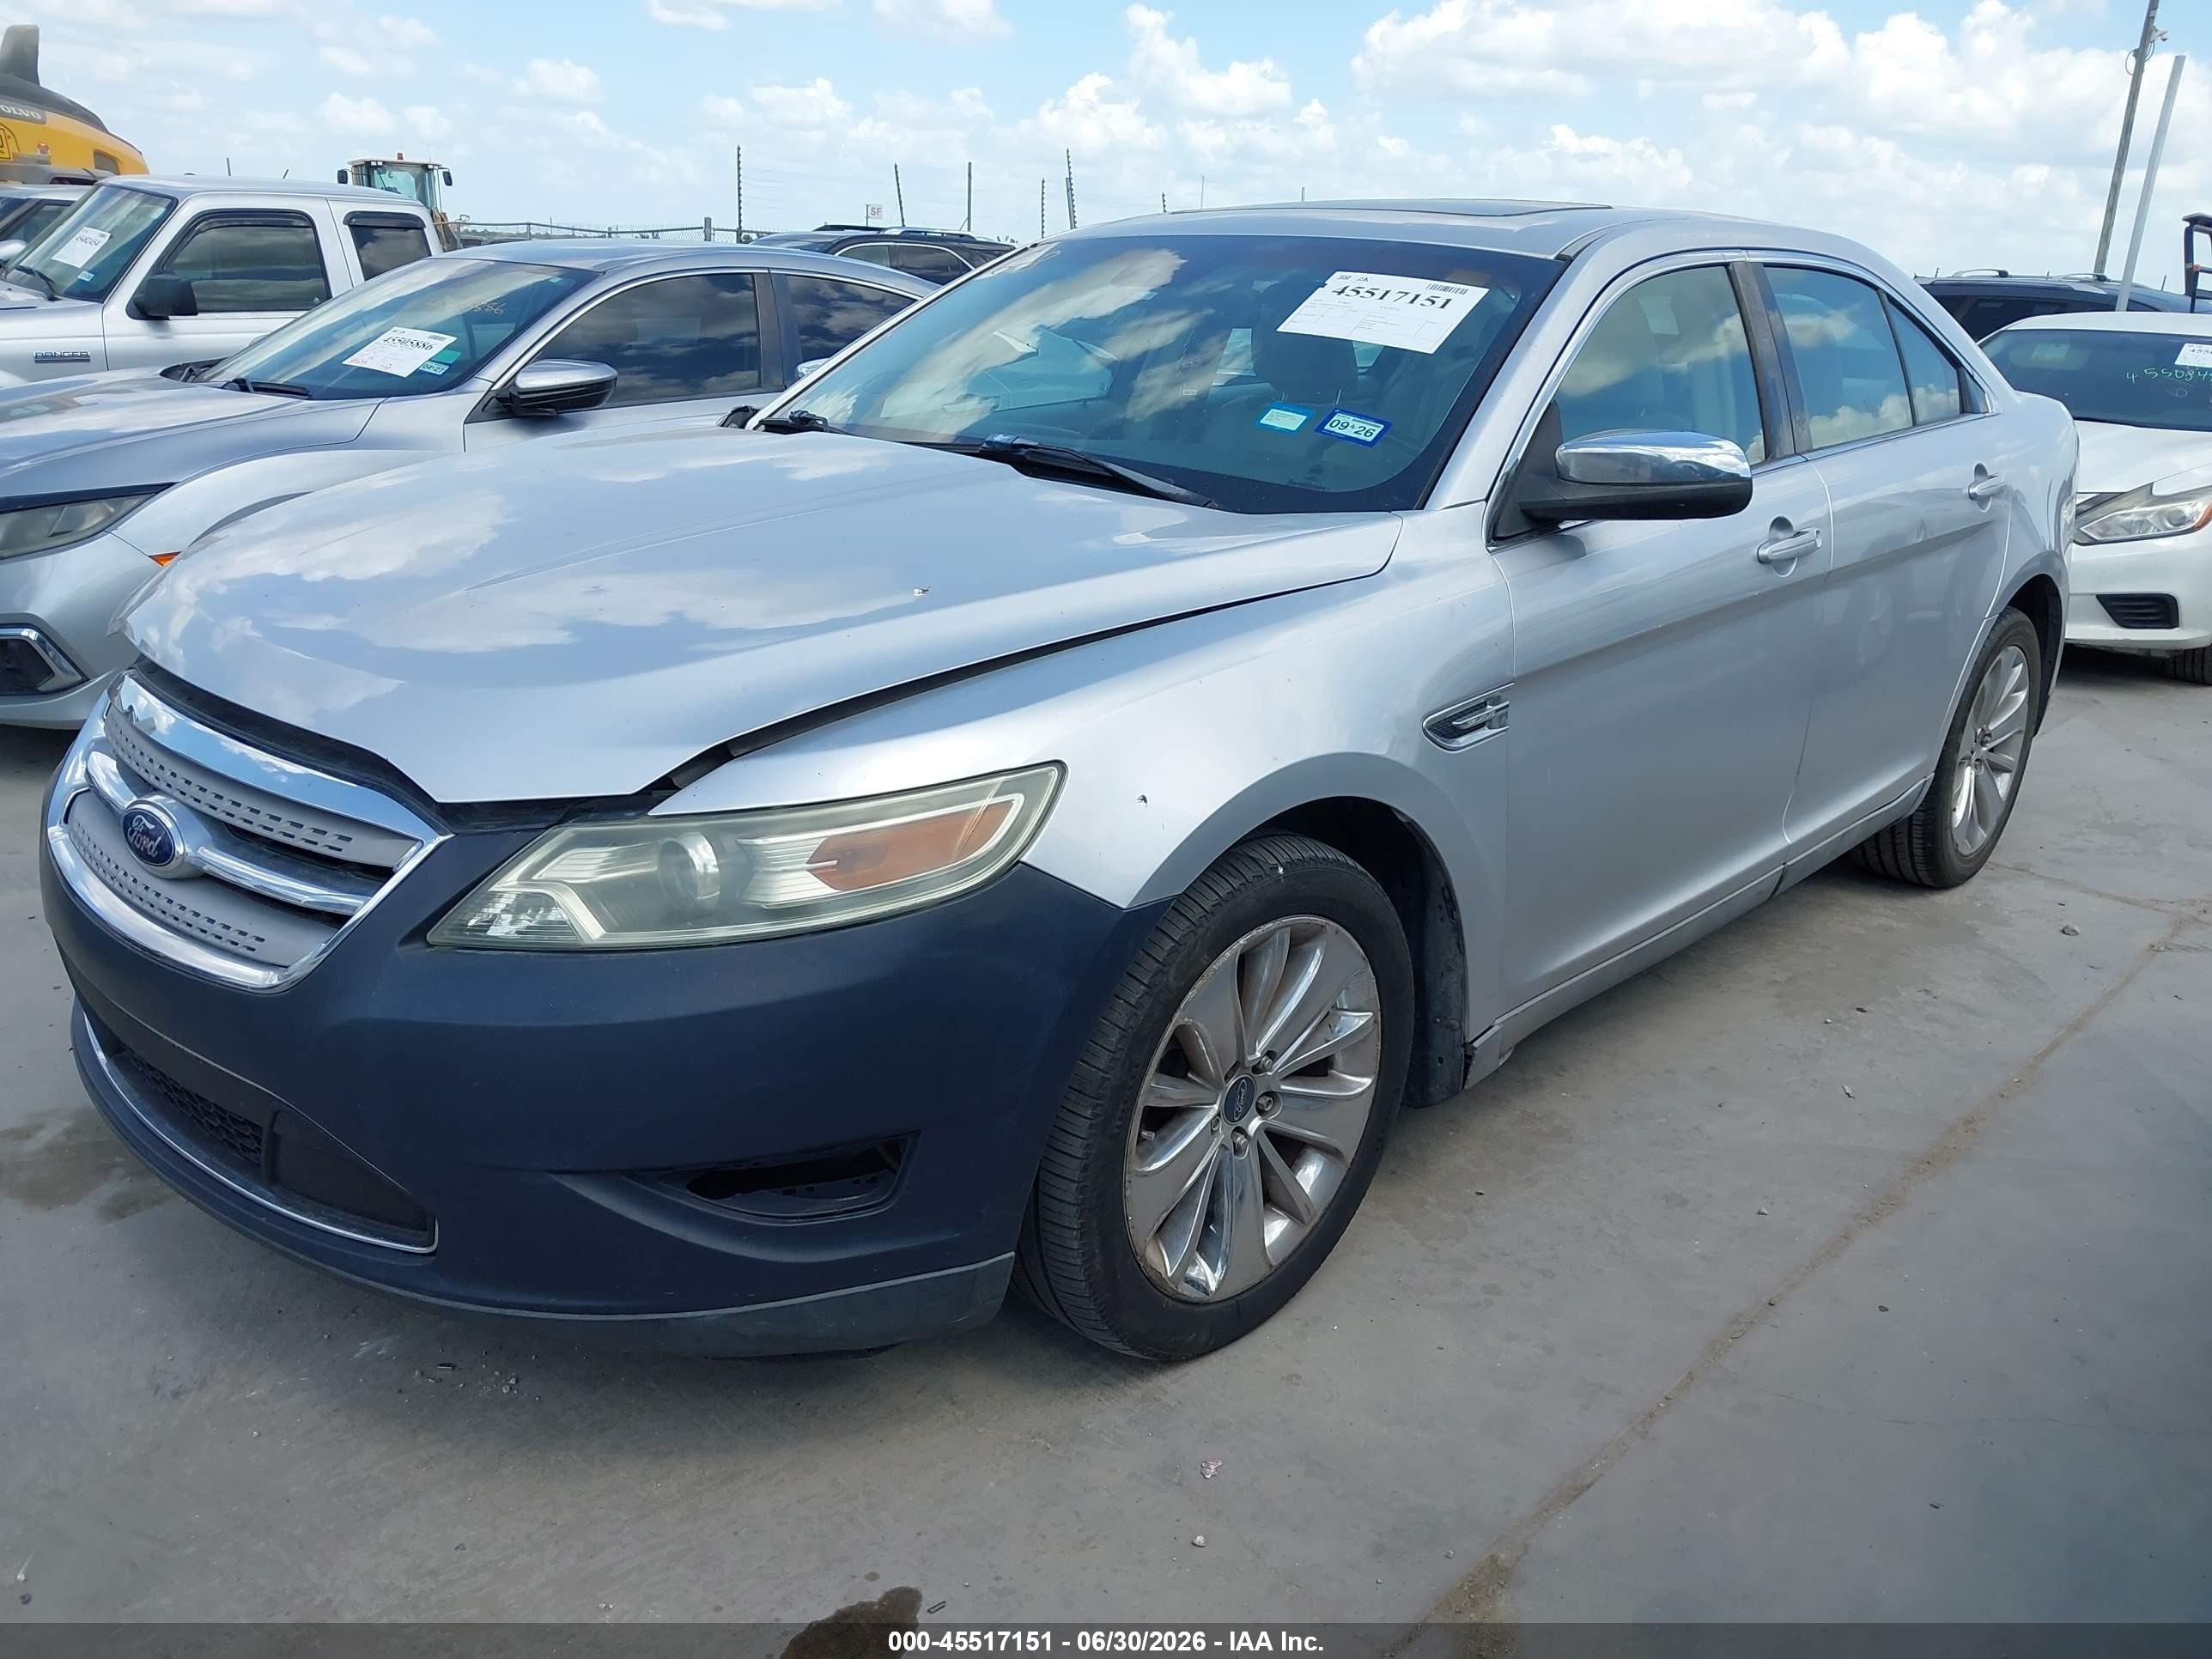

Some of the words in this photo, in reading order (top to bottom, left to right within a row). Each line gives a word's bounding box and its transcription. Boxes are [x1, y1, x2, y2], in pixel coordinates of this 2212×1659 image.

[871, 207, 882, 216] SF
[1332, 284, 1453, 309] 45517151
[383, 336, 434, 350] 45505886
[128, 814, 161, 856] Ford
[1236, 1087, 1246, 1113] Ford
